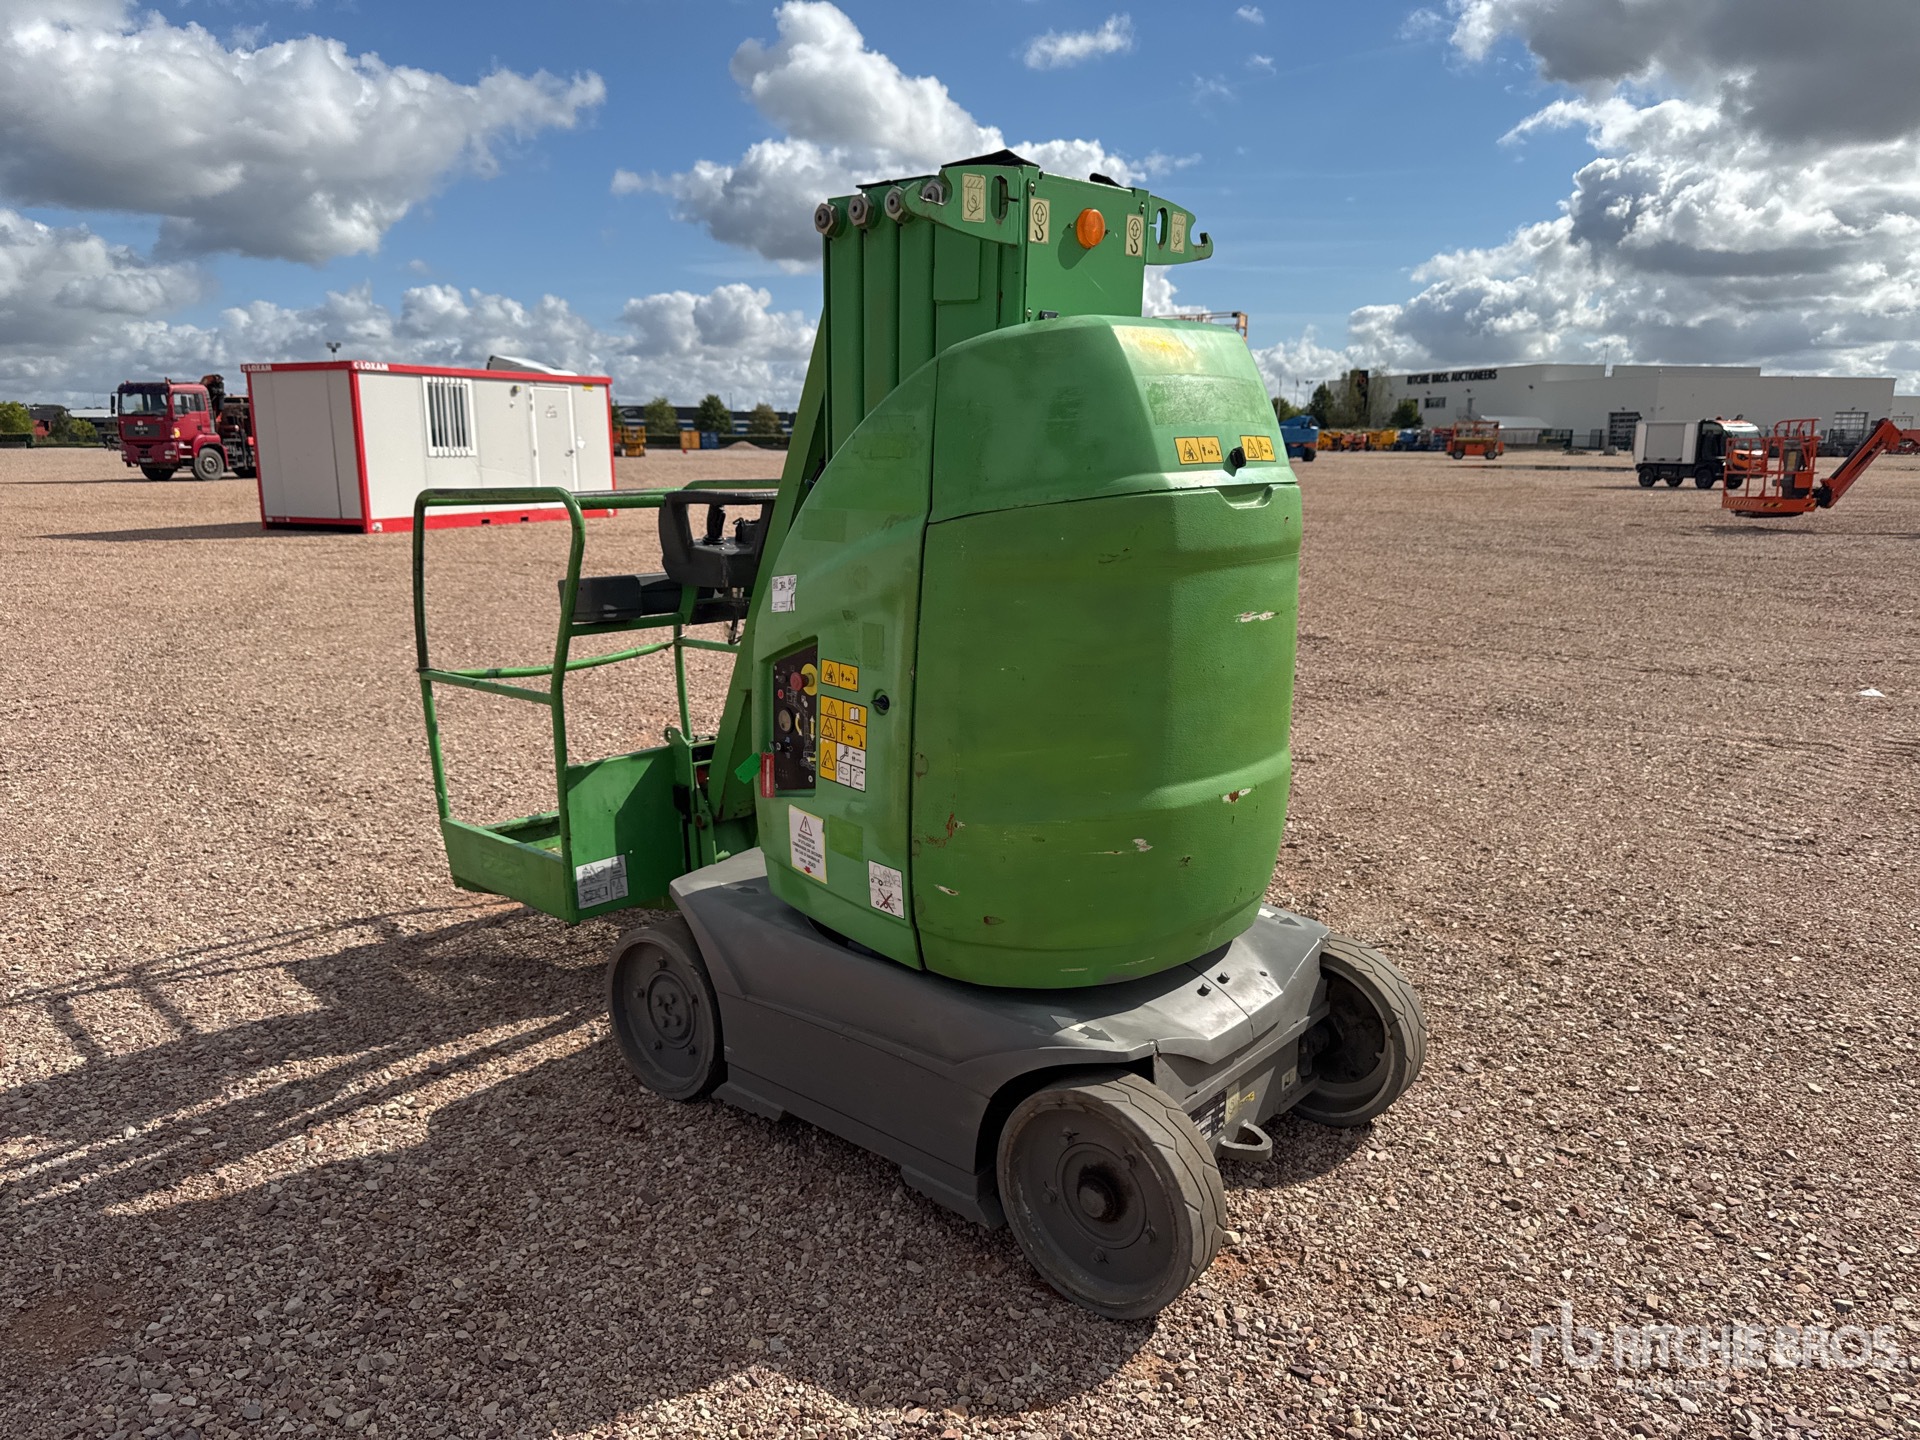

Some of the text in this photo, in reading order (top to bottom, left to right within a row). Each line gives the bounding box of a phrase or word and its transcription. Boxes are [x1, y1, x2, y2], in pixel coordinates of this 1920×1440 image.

[247, 364, 272, 372] LOXAM
[360, 362, 389, 371] LOXAM
[1407, 374, 1430, 385] RITCHIE
[1451, 369, 1497, 381] AUCTIONEERS
